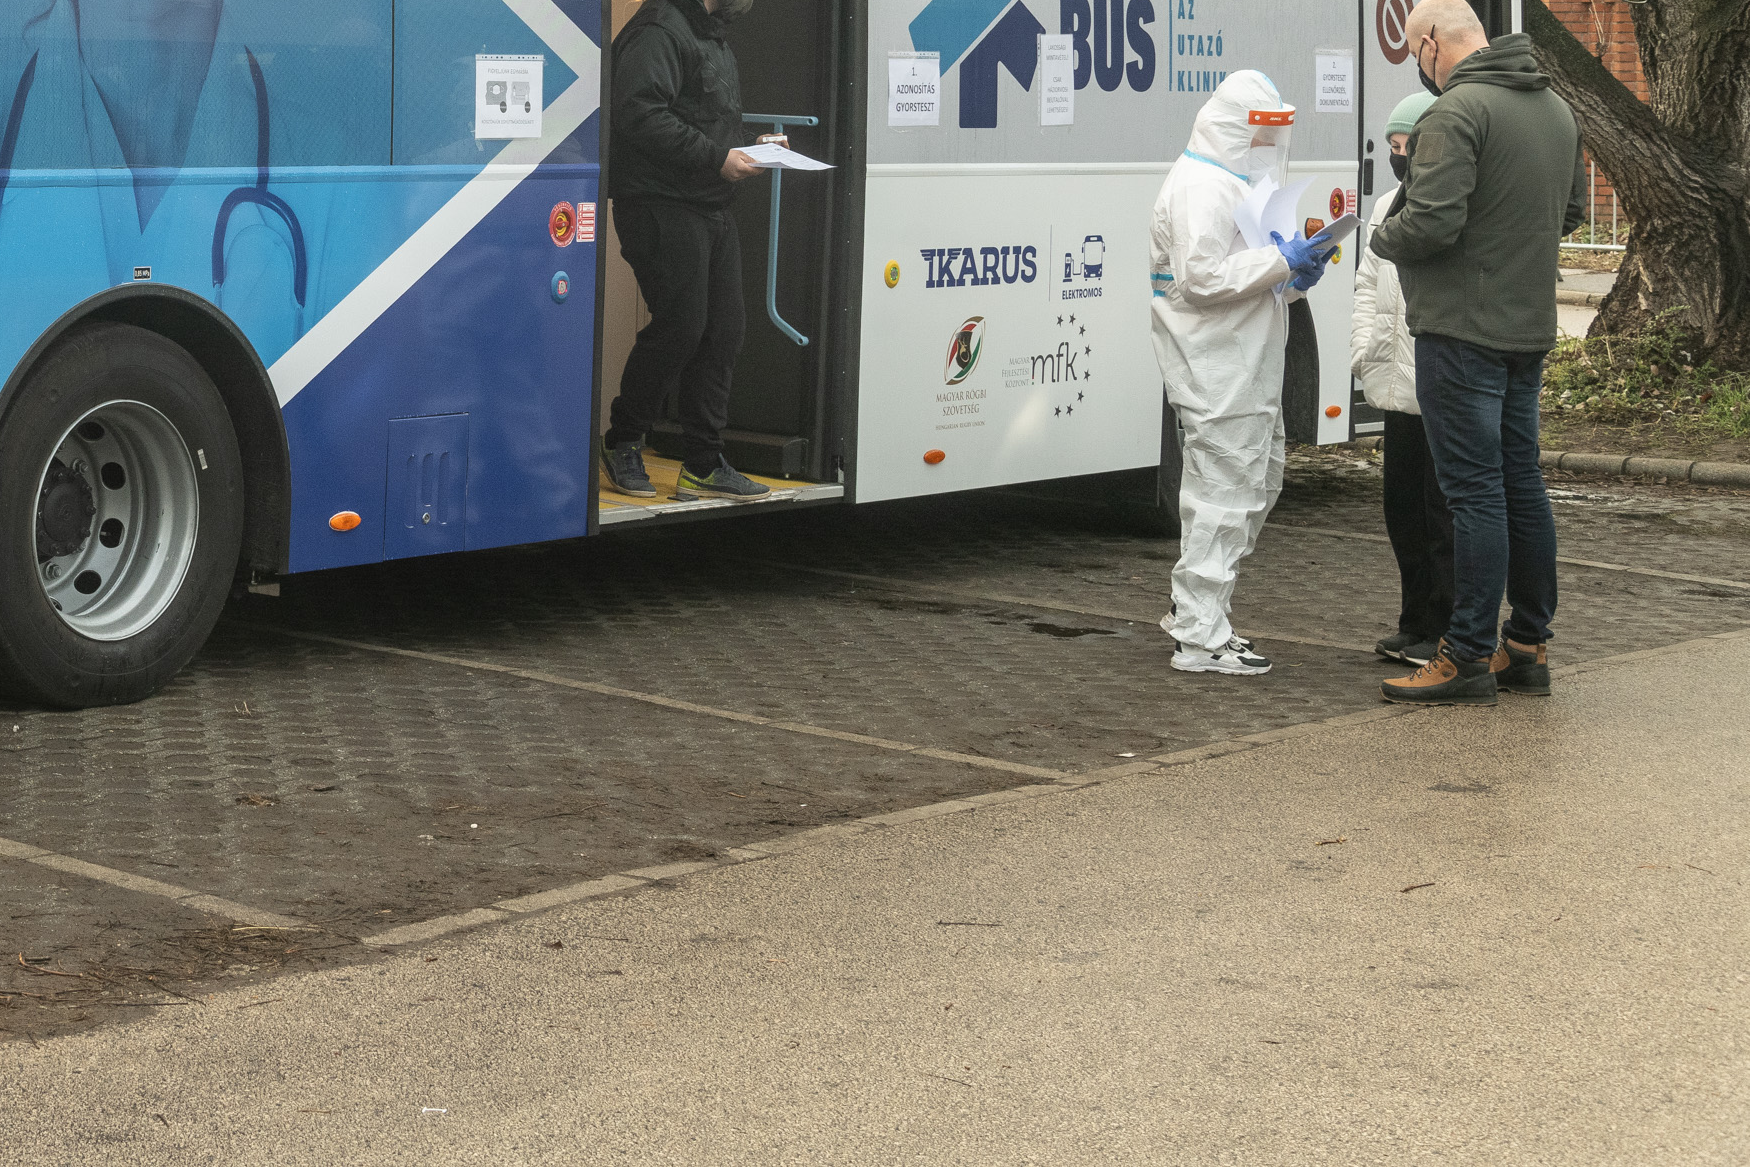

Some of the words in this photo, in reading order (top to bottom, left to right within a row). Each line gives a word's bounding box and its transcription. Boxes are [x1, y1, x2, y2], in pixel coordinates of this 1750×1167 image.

[1177, 30, 1223, 56] UTAZÓ
[912, 66, 918, 77] 1.
[1177, 70, 1234, 92] KLINIK
[896, 82, 935, 95] AZONOSÍTÁS
[895, 102, 935, 112] GYORSTESZT
[919, 245, 1037, 289] IKARUS
[1061, 287, 1103, 300] ELEKTROMOS
[1031, 341, 1078, 386] mfk
[935, 391, 965, 403] MAGYAR
[942, 401, 980, 417] SZÖVETSÉG
